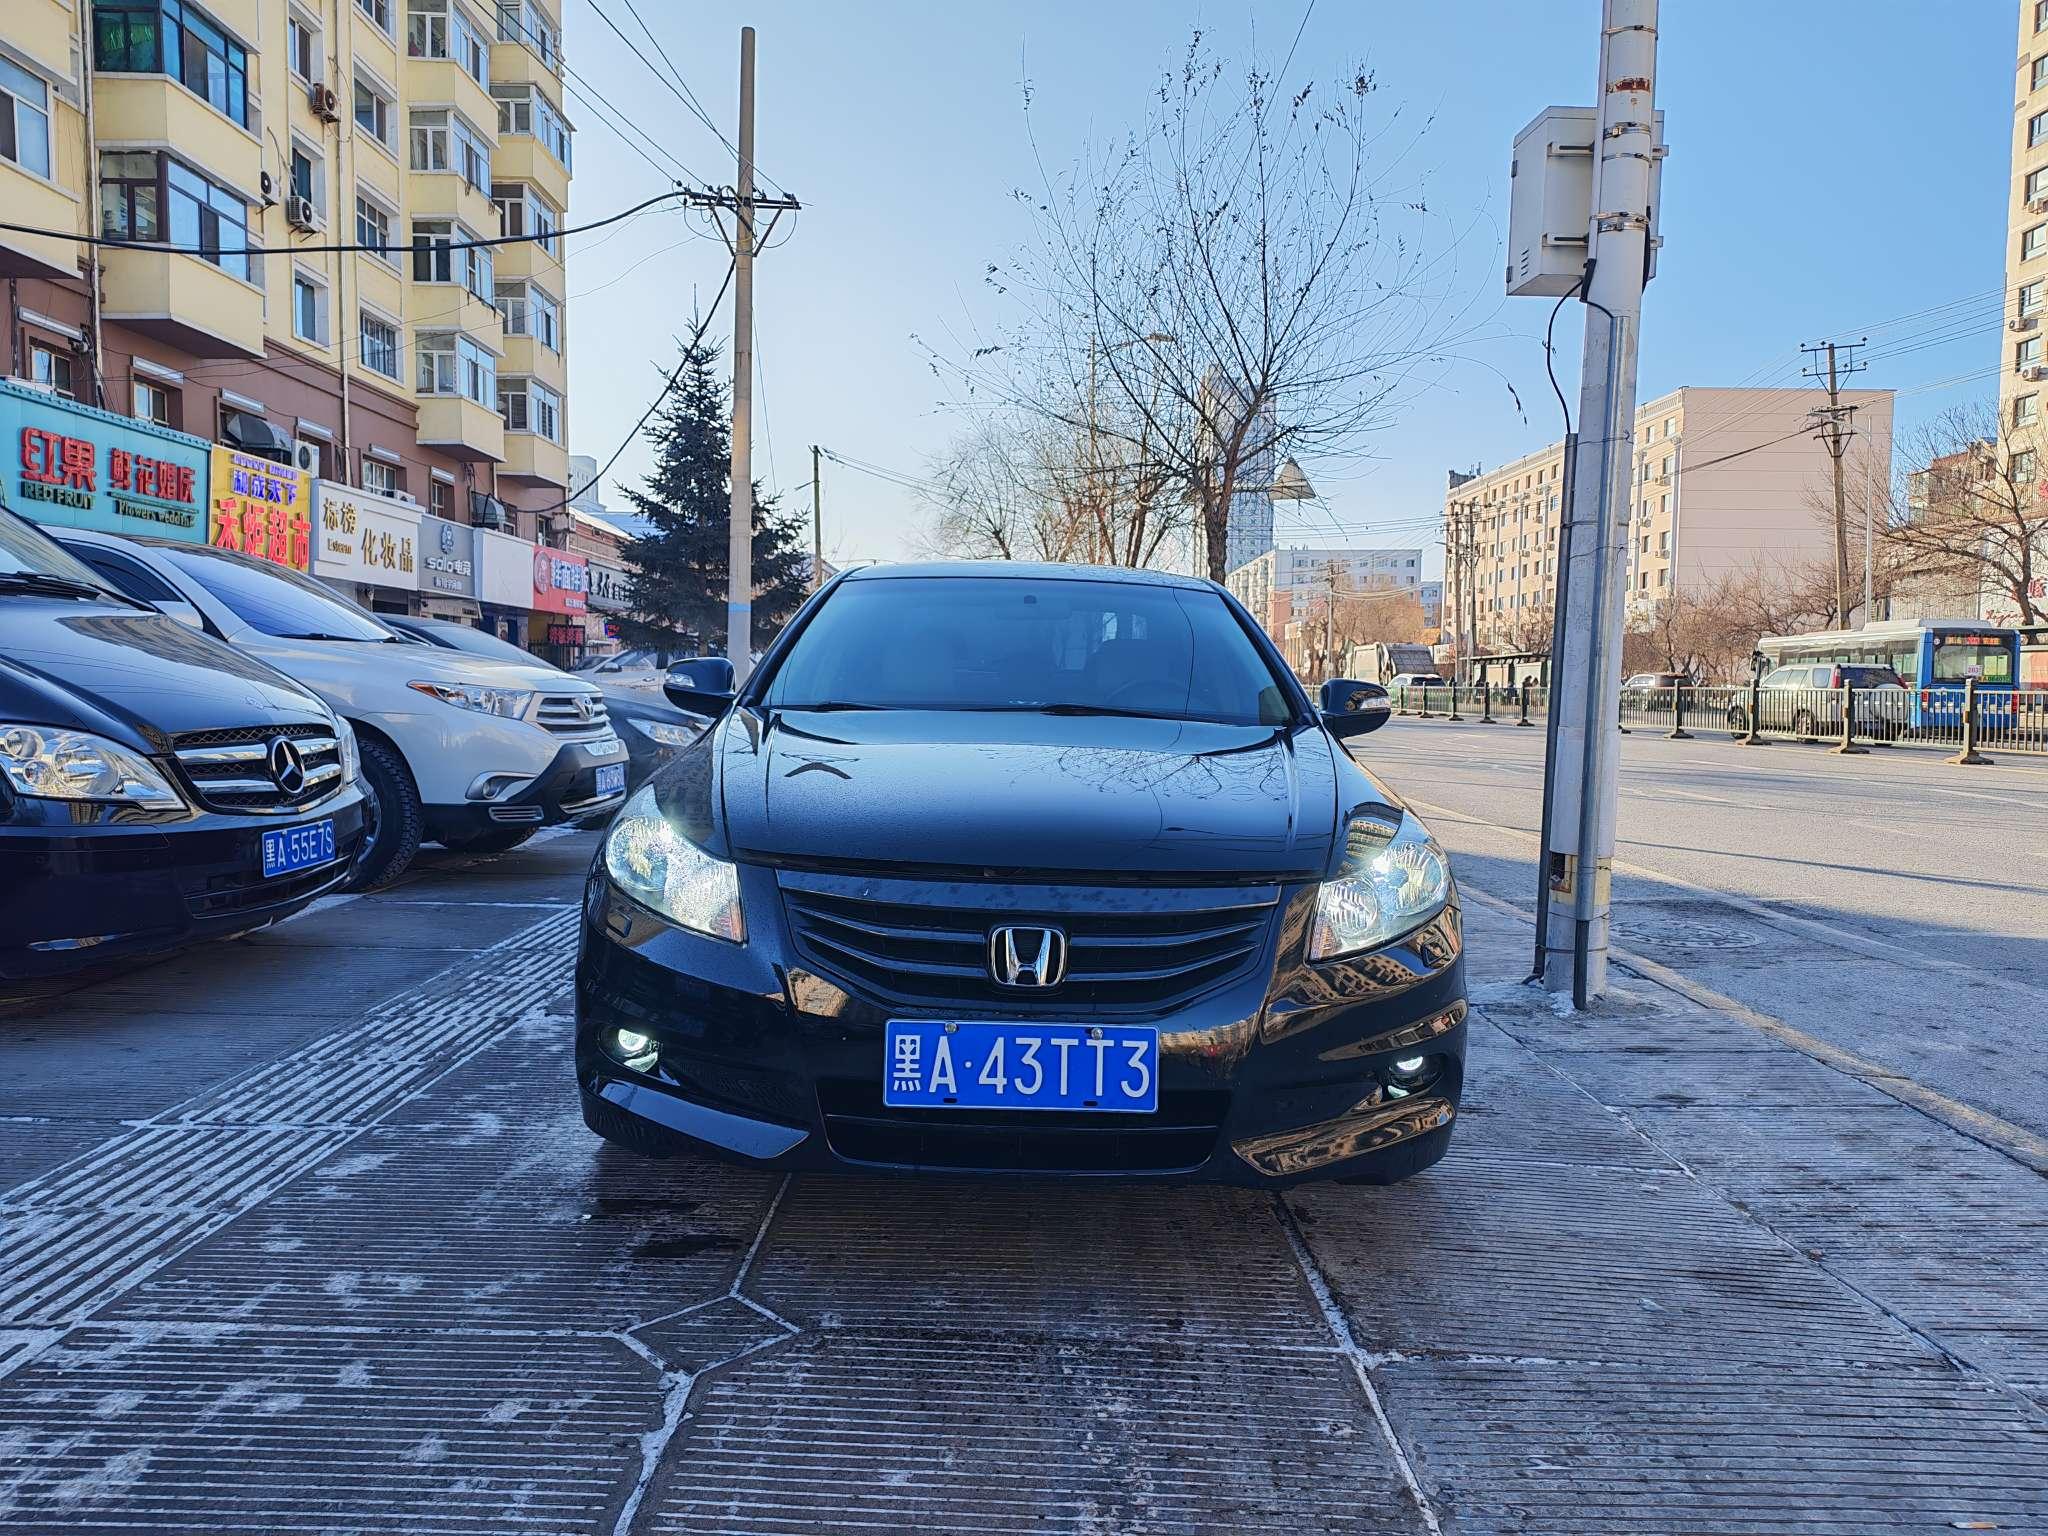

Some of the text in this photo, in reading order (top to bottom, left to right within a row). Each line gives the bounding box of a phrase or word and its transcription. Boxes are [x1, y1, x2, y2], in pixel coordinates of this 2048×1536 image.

[22, 426, 97, 492] 红果
[111, 448, 195, 503] 鲜花婚庆
[23, 482, 54, 501] RED
[361, 528, 413, 573] 化妆品
[893, 1034, 1150, 1098] 黑A·43TT3
